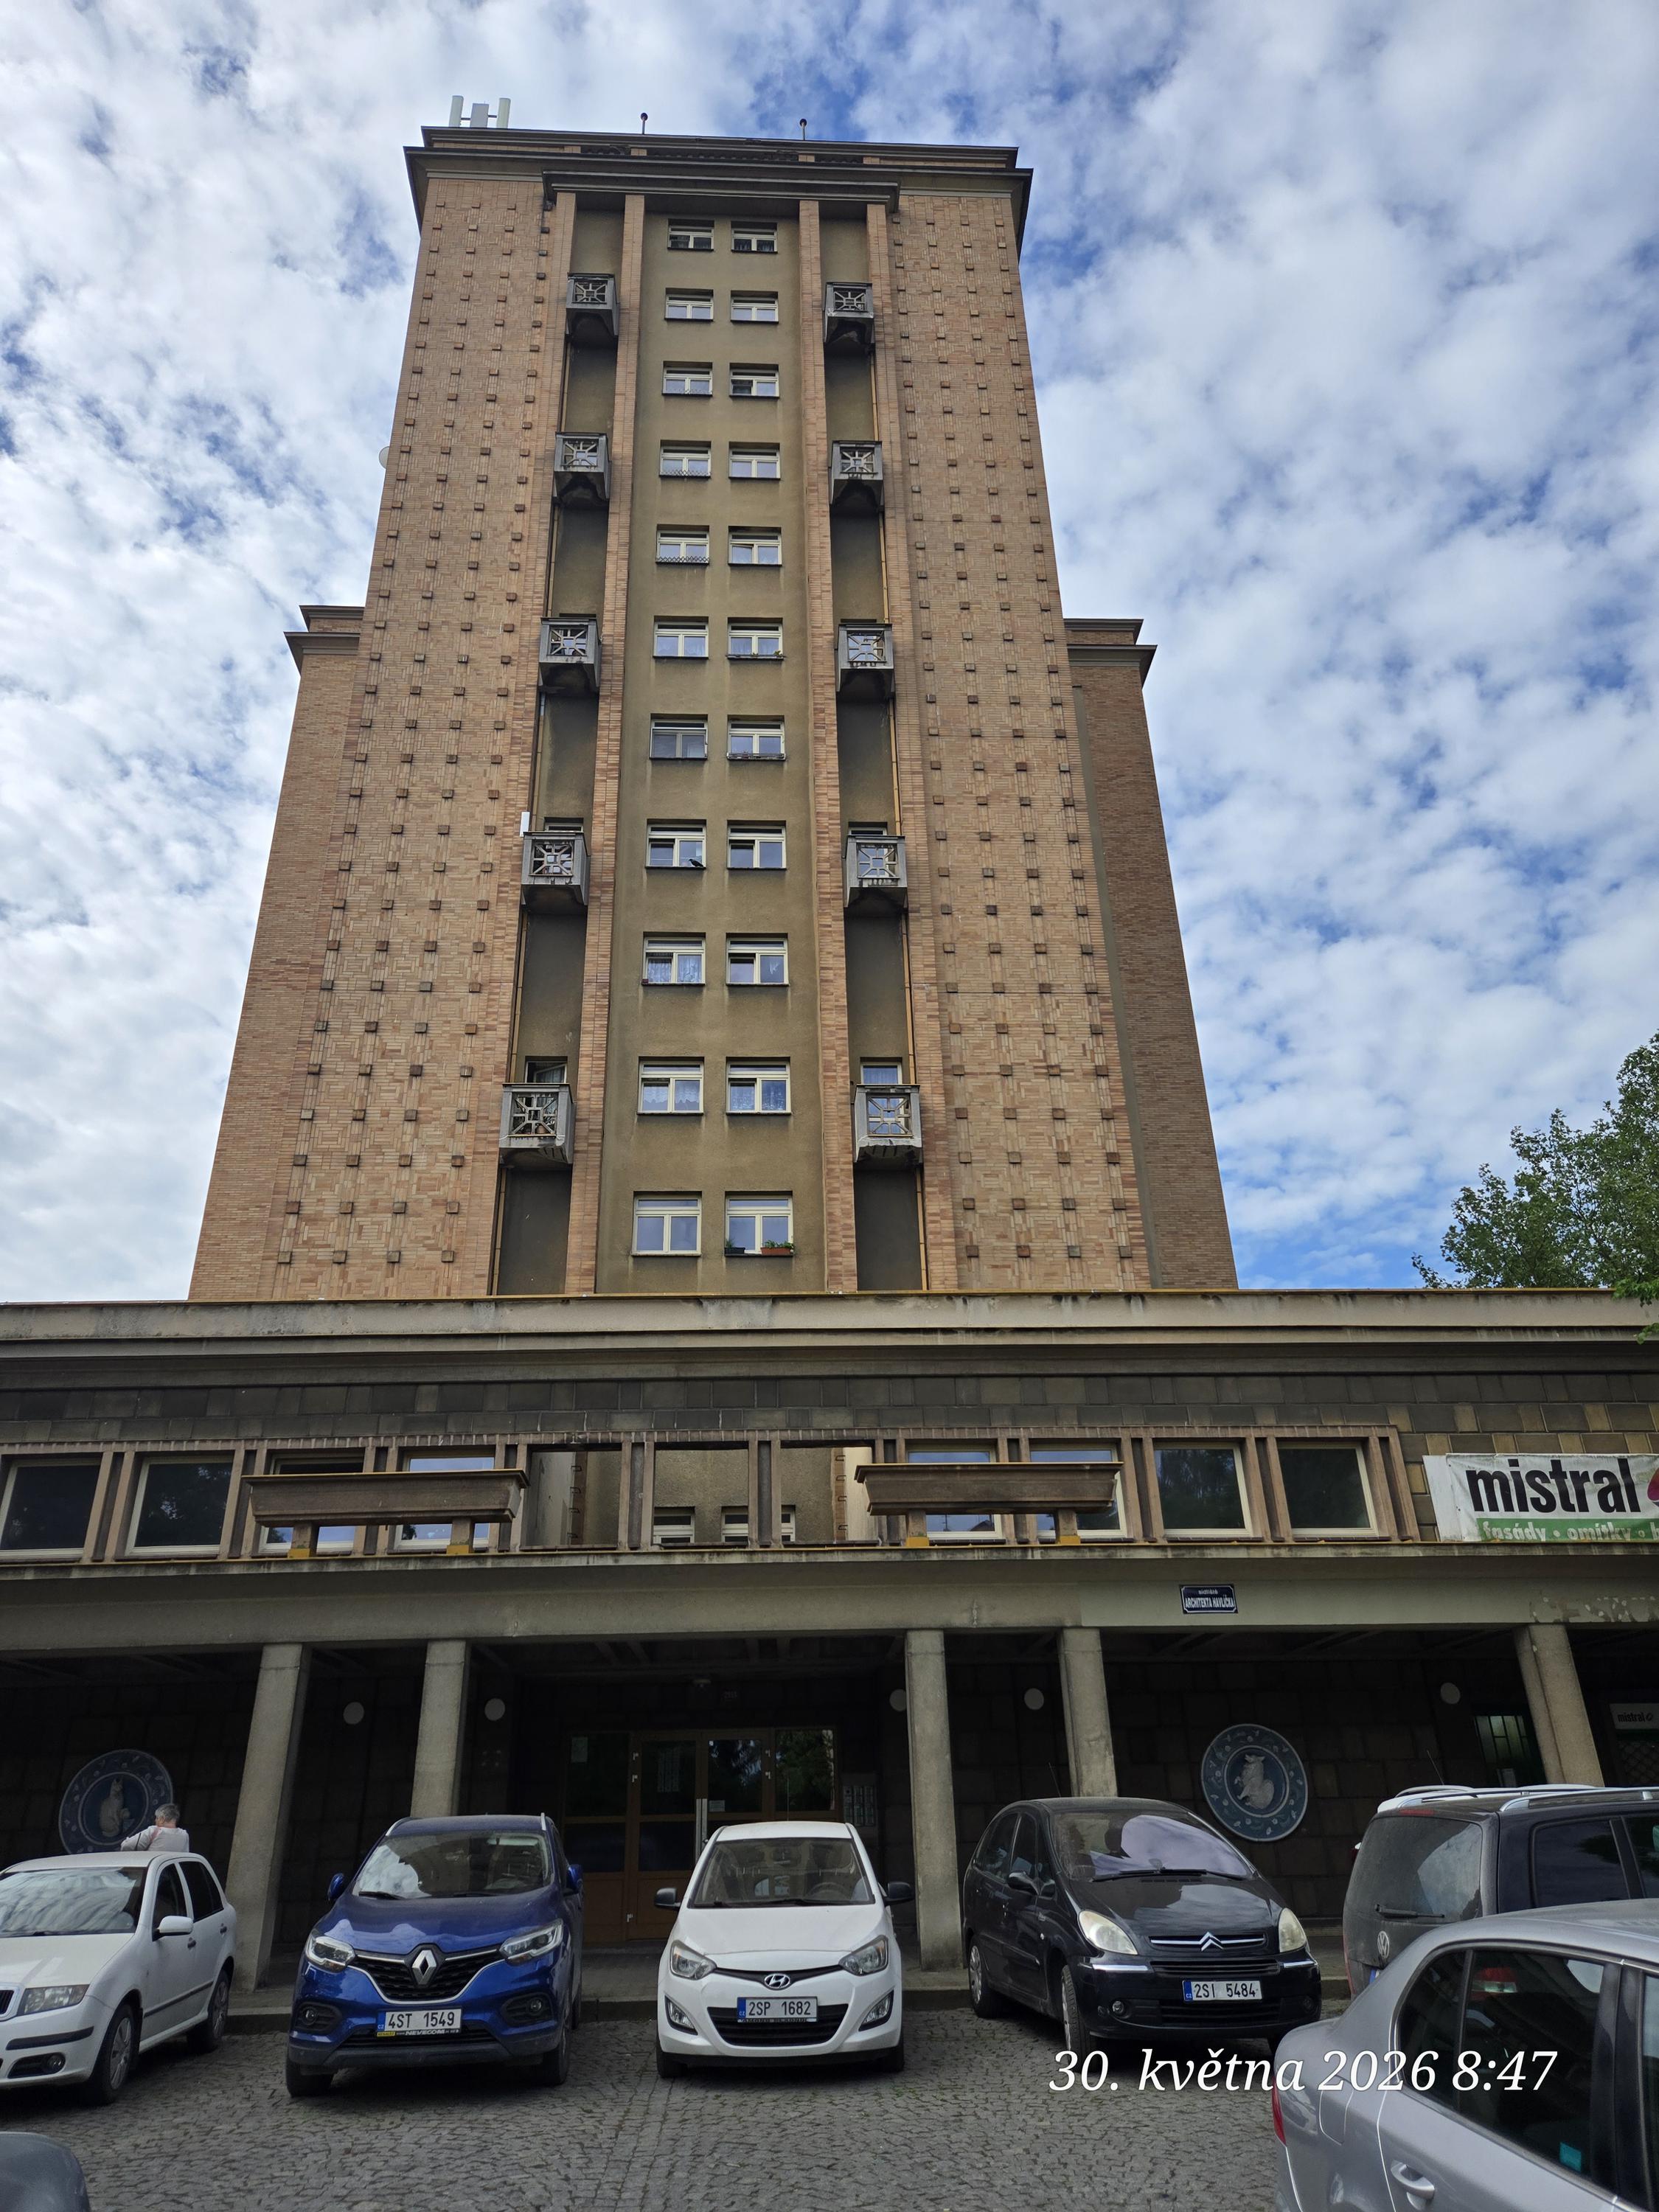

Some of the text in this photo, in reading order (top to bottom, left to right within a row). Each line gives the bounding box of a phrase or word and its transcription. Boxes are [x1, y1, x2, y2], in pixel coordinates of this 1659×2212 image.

[1466, 1458, 1641, 1513] mistral
[1483, 1521, 1546, 1542] fasády
[1618, 1712, 1645, 1722] mistral
[1225, 1983, 1256, 1997] 5484
[748, 2000, 811, 2016] 2SP 1682
[388, 2011, 455, 2028] 4ST 1549
